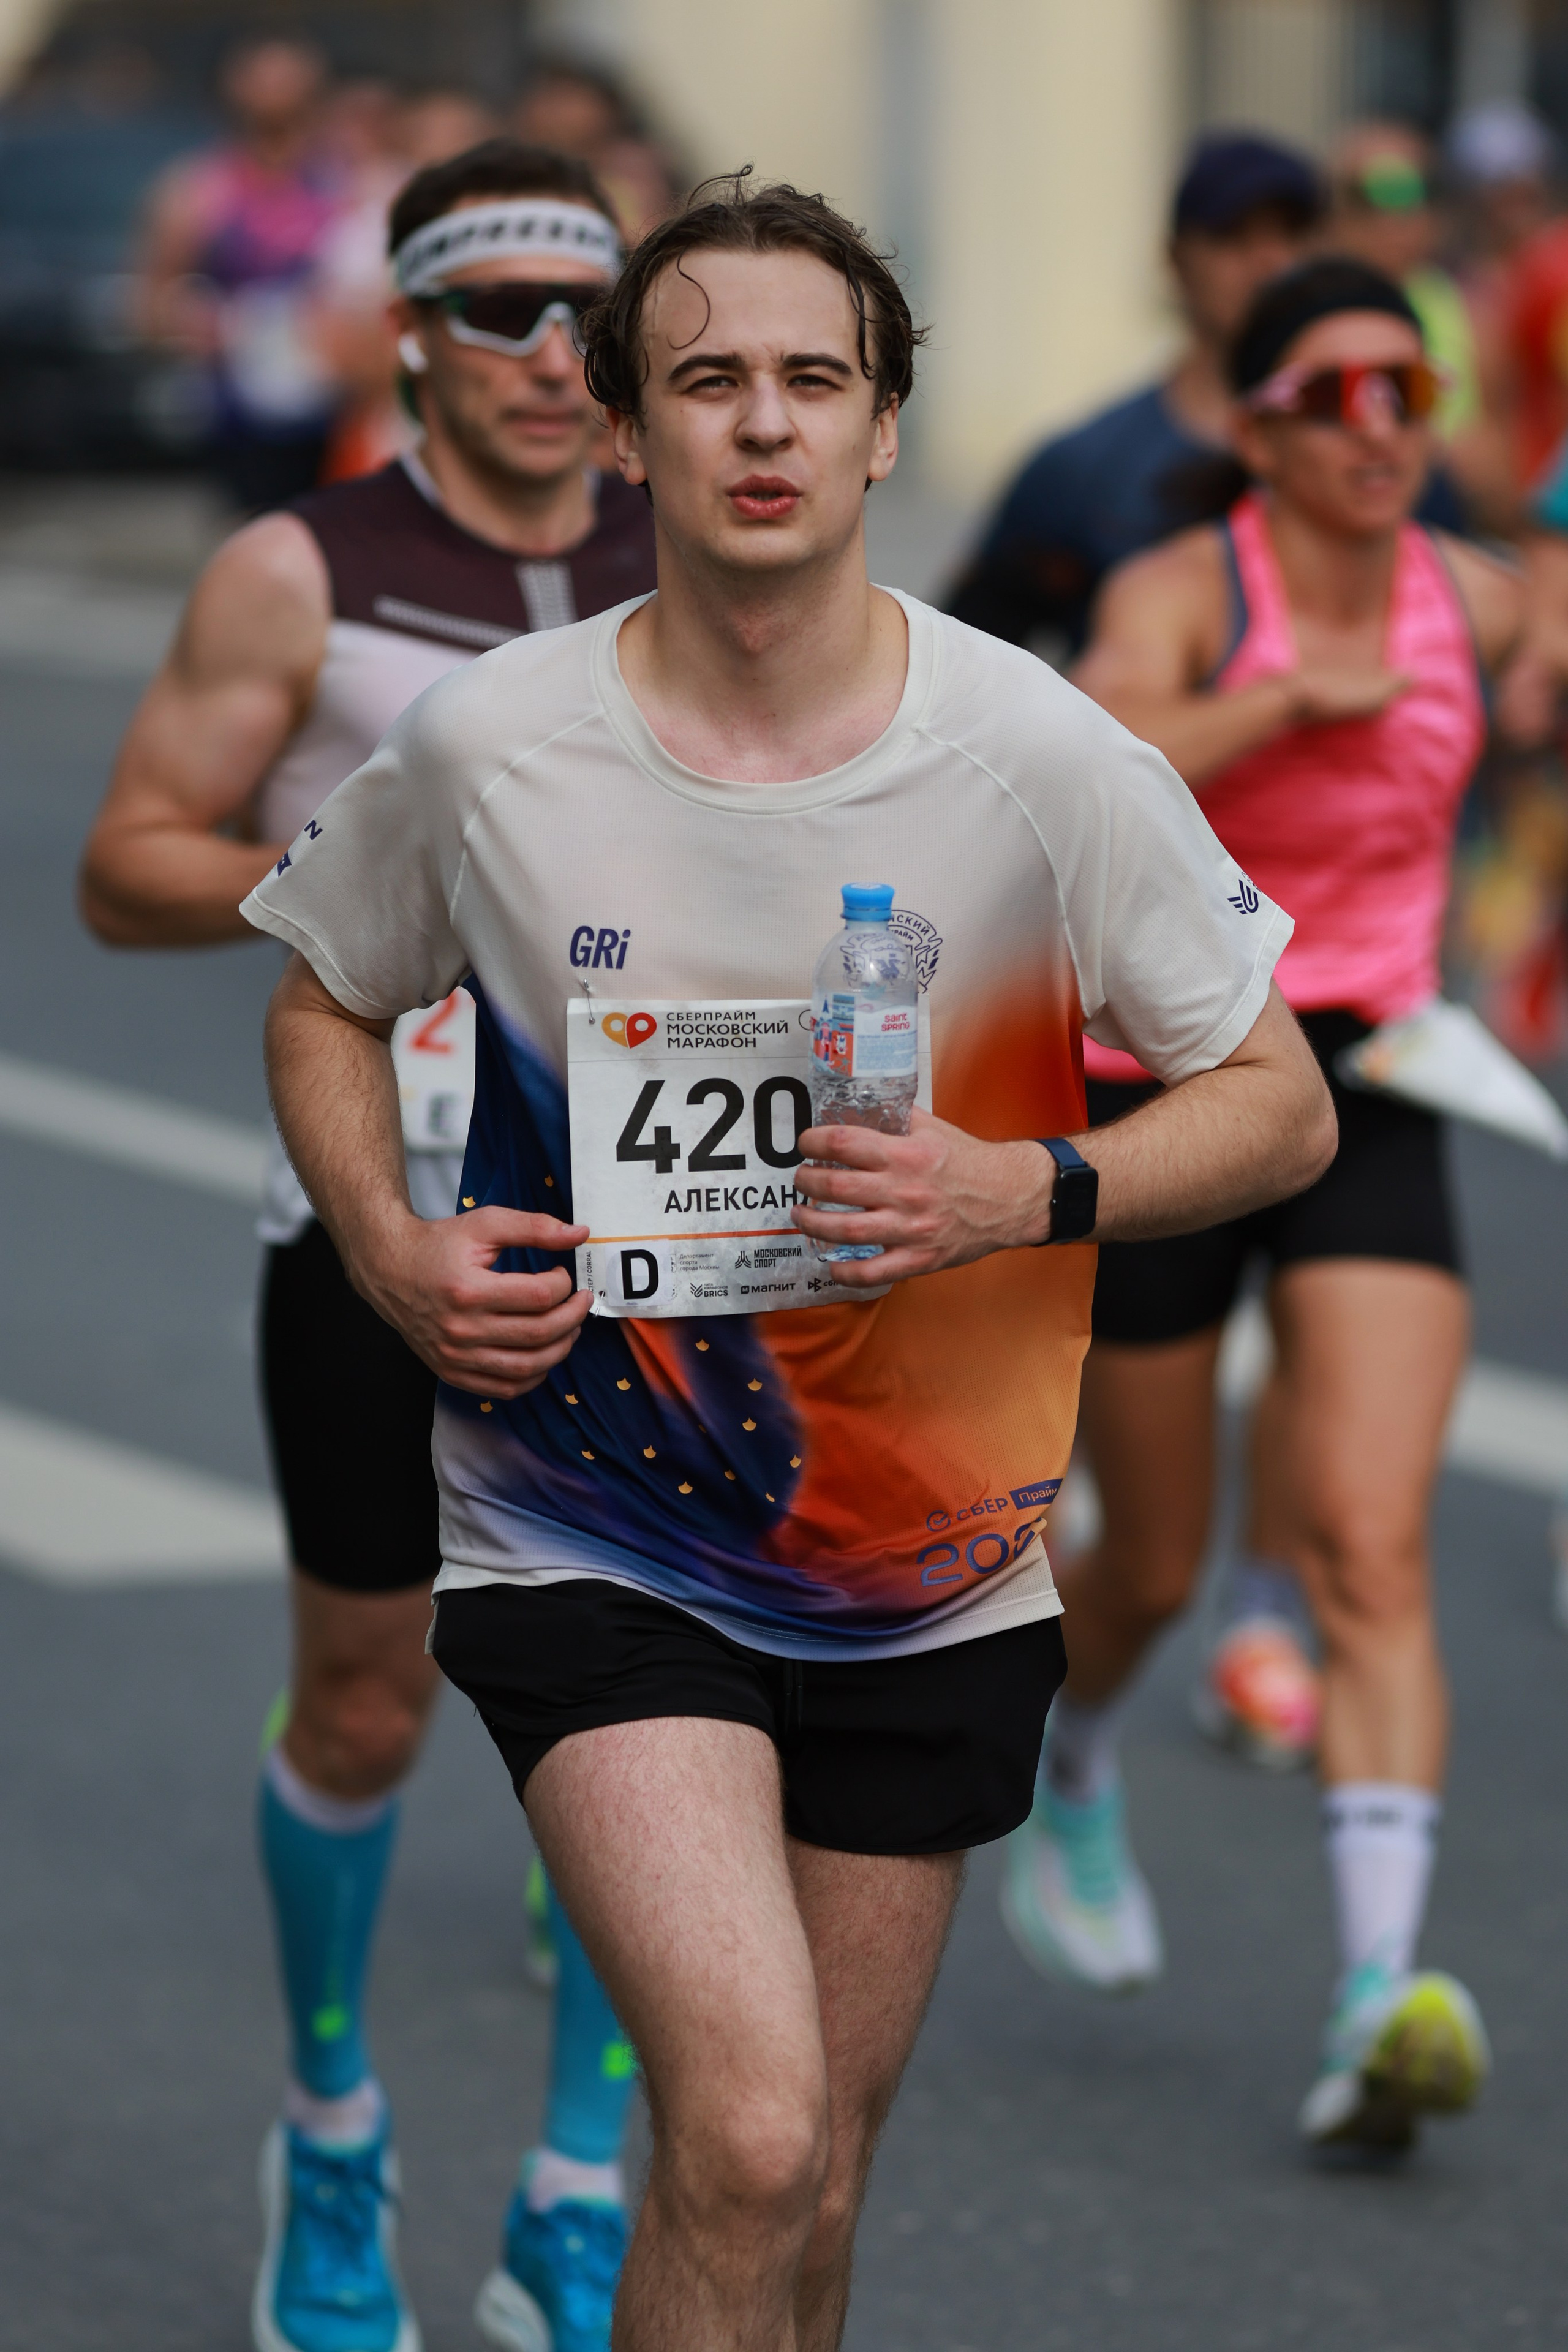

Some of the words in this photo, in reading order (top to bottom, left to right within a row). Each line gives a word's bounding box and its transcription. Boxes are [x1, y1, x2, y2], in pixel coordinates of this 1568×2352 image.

[570, 925, 631, 970] GRi
[666, 1010, 756, 1021] СБЕРПРАЙМ
[666, 1020, 789, 1035] МОСКОВСКИЙ
[667, 1037, 757, 1049] МАРАФОН
[753, 1245, 802, 1260] МОСКОВСКИЙ
[754, 1257, 777, 1269] СПОРТ
[620, 1249, 659, 1300] D
[704, 1289, 728, 1298] BRICS
